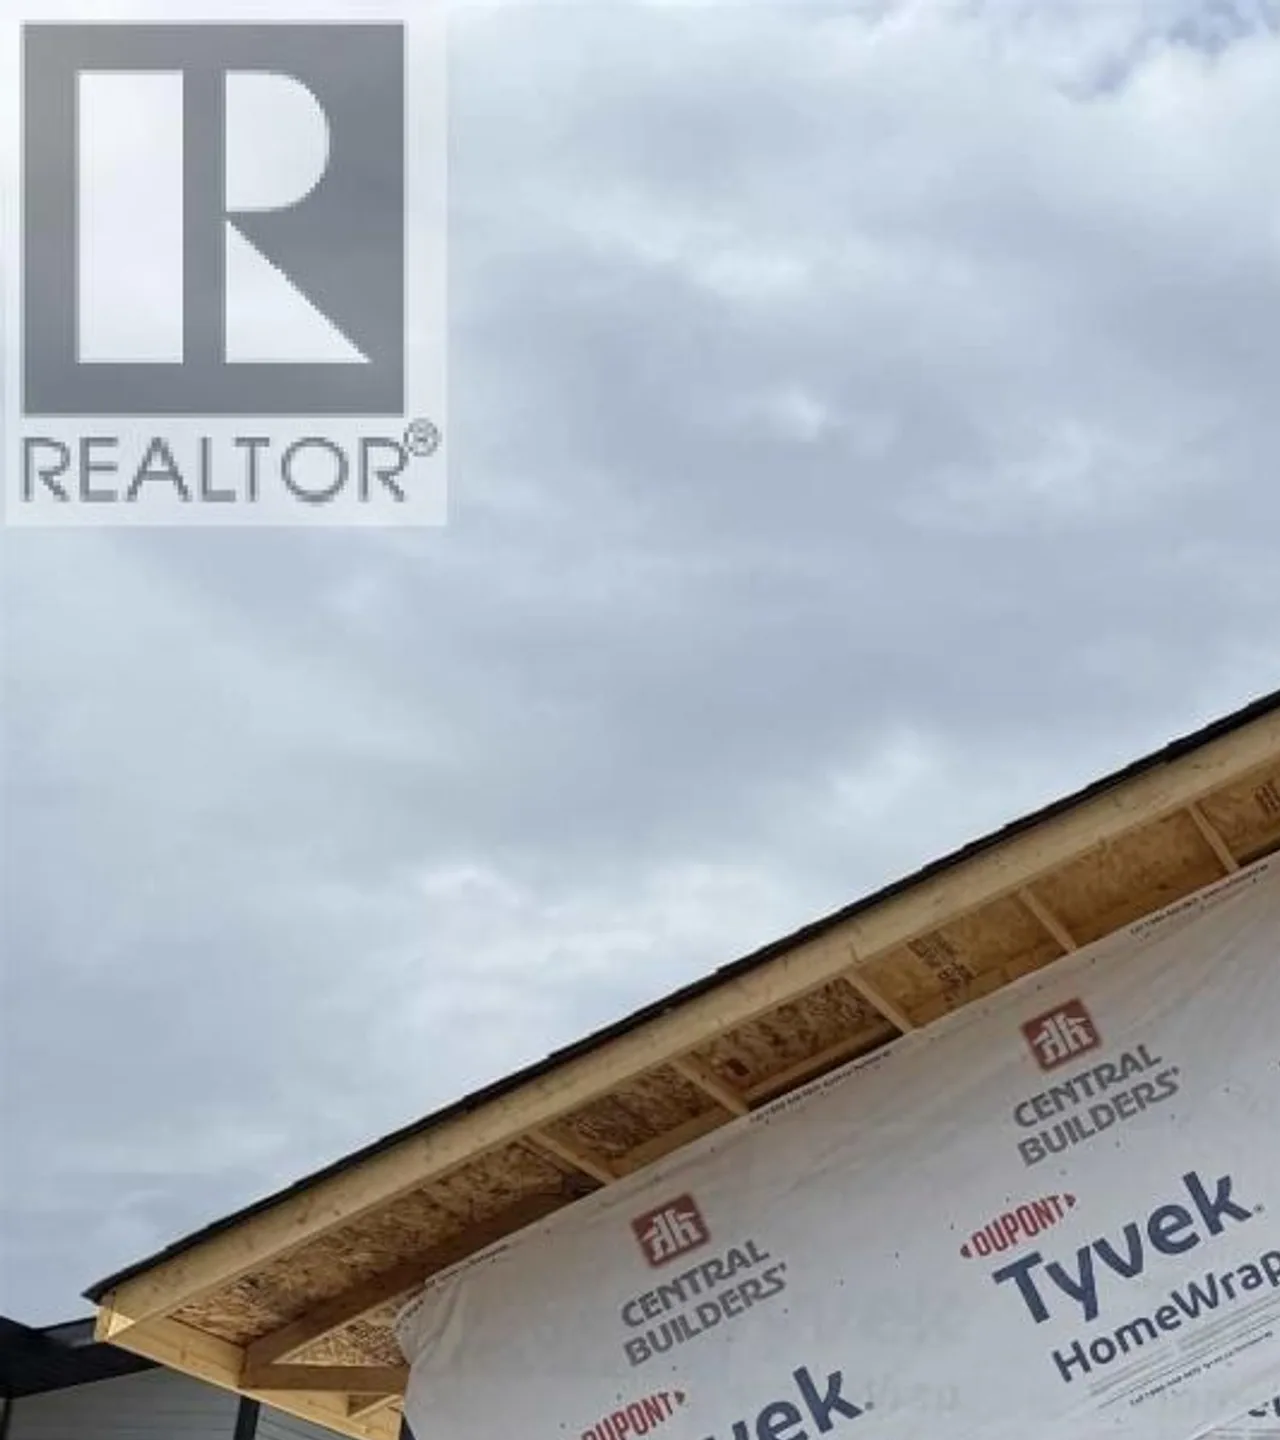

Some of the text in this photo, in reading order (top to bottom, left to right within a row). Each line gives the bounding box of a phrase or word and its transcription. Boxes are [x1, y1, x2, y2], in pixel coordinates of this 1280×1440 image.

[1012, 1043, 1163, 1129] CENTRAL
[972, 1194, 1066, 1258] DUPONT
[992, 1170, 1253, 1324] Tyvek
[620, 1240, 770, 1328] CENTRAL
